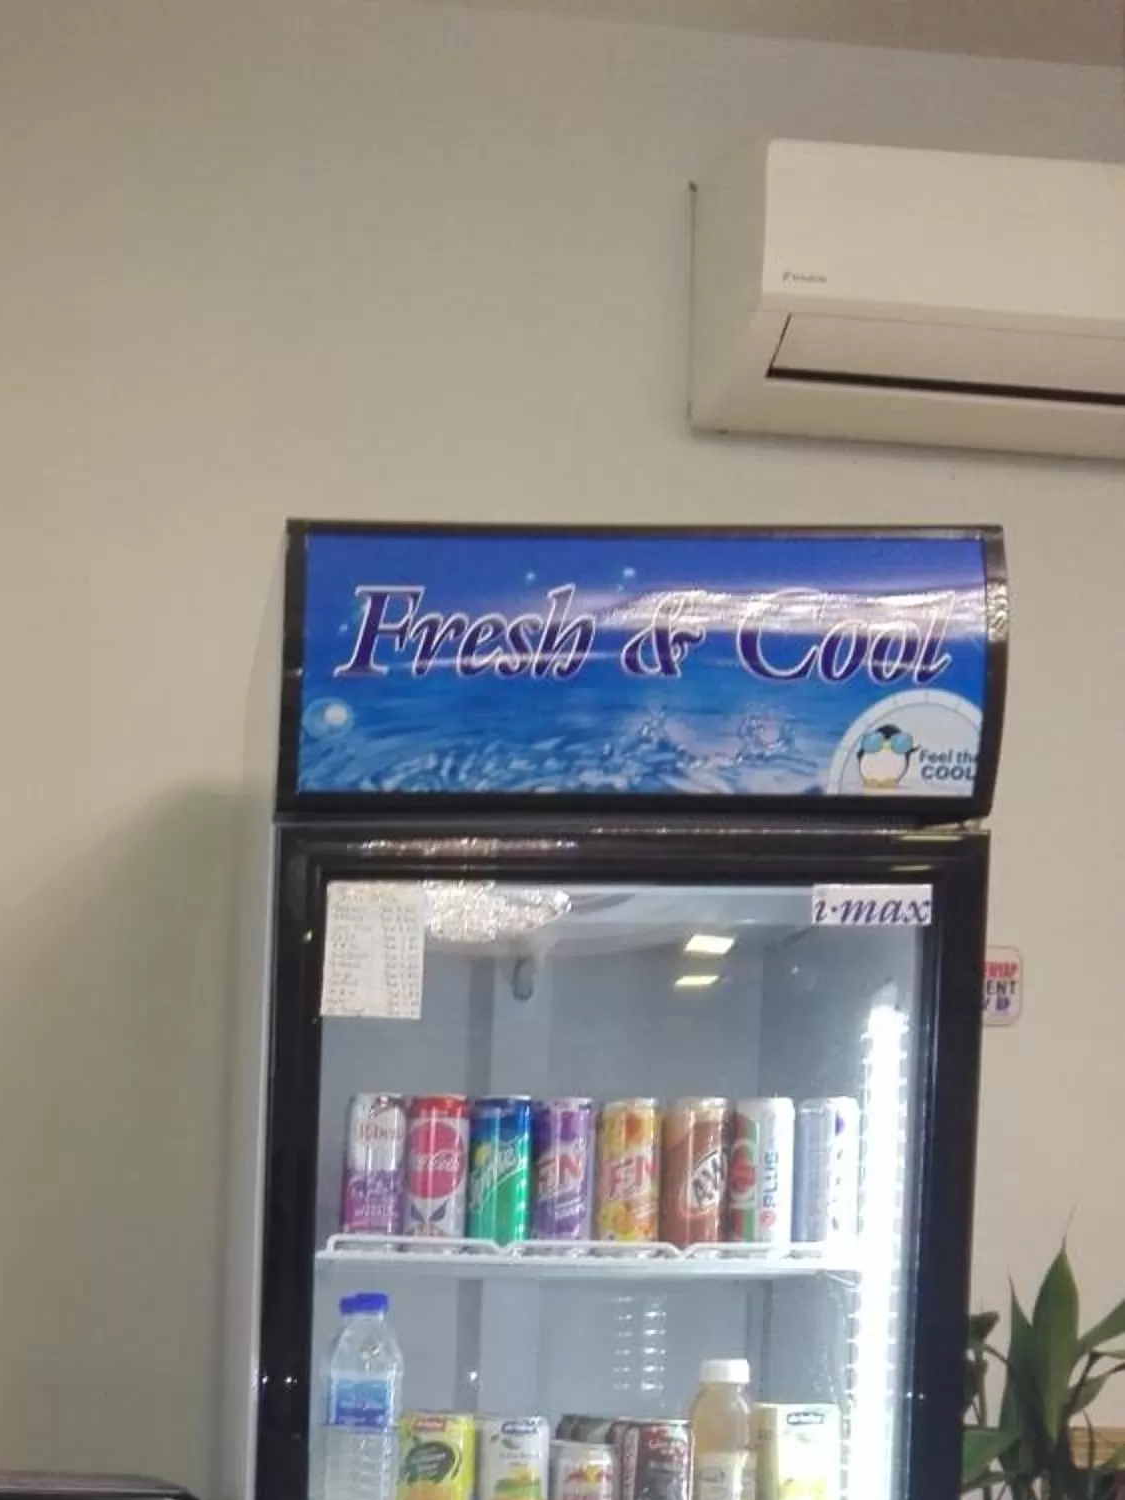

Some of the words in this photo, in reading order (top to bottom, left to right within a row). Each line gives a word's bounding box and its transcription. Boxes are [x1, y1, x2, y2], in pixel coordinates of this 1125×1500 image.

[334, 583, 596, 679] Fresh
[621, 588, 707, 680] &
[737, 586, 956, 684] Cool
[919, 747, 953, 764] Feel
[920, 764, 975, 781] COOL
